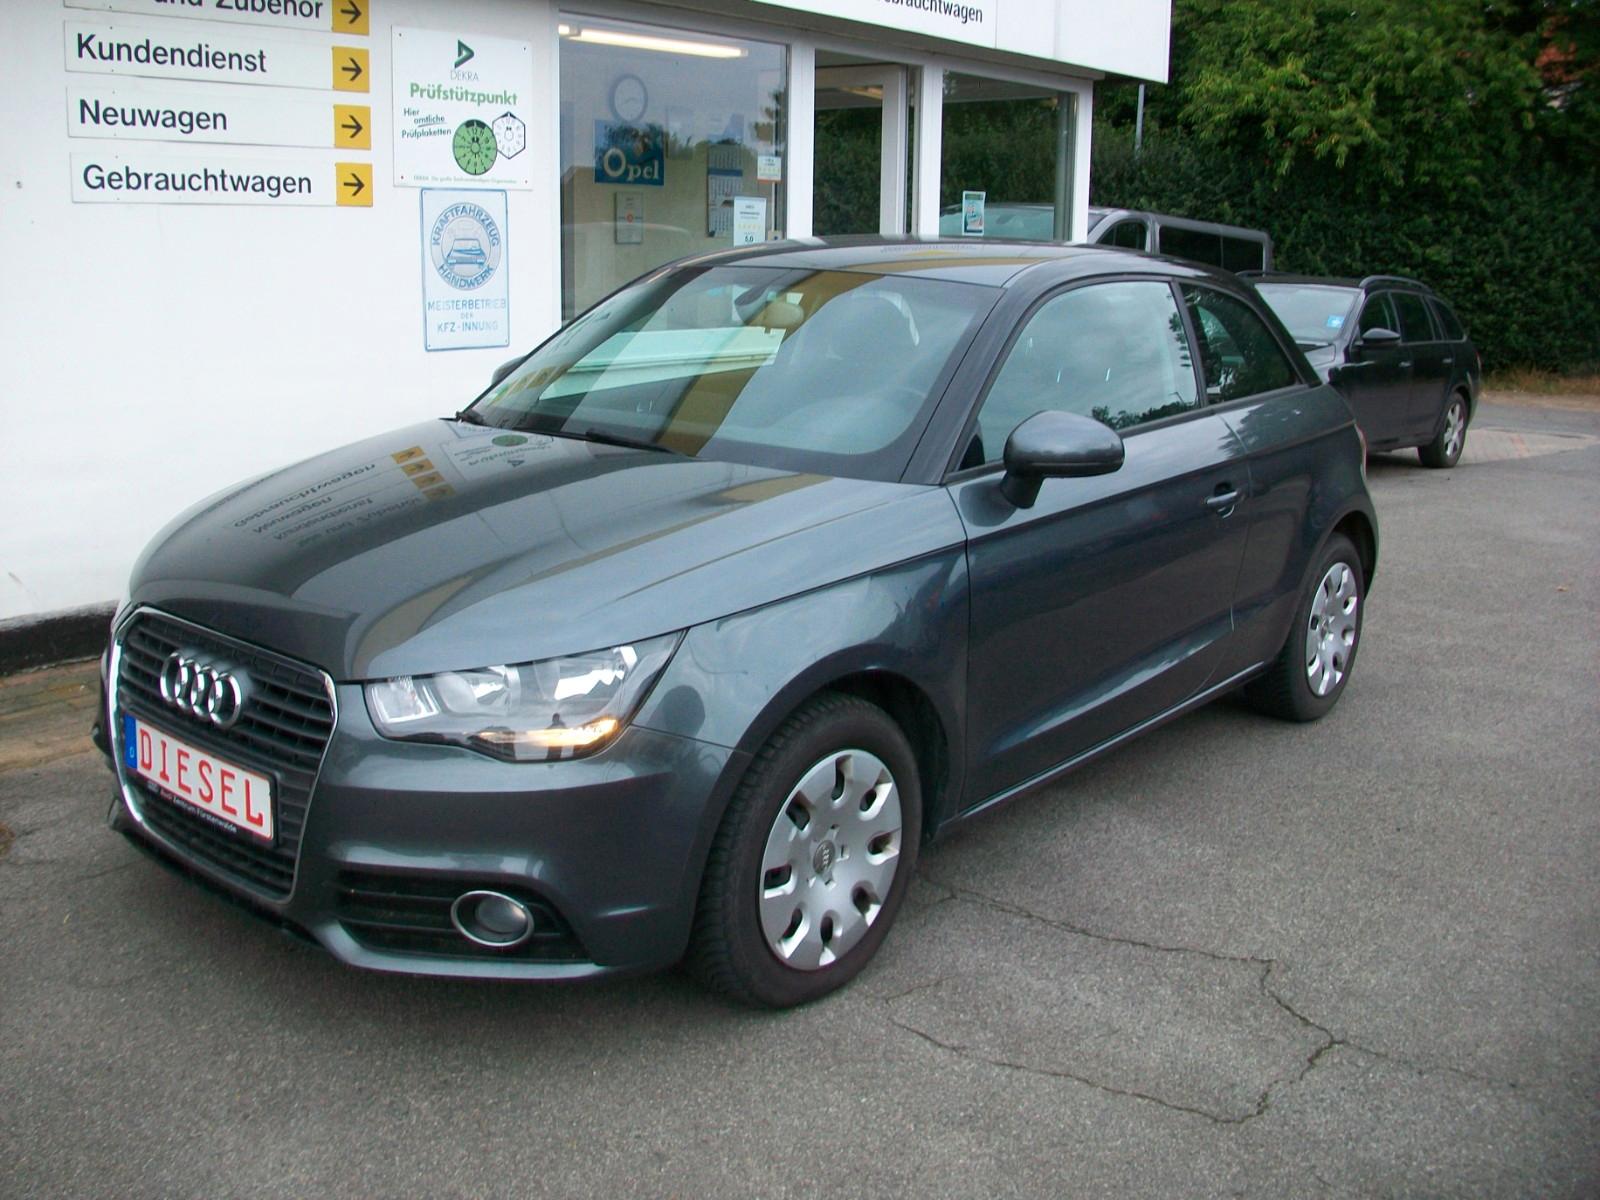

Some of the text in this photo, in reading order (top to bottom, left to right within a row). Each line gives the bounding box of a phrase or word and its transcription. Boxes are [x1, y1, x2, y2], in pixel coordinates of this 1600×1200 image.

[77, 32, 267, 73] Kundendienst
[450, 70, 479, 81] DEKRA
[410, 82, 518, 106] Prüfstützpunkt
[79, 98, 228, 134] Neuwagen
[403, 107, 420, 116] Hier
[413, 114, 446, 124] amtliche
[401, 128, 452, 139] Prüfplaketten
[603, 147, 660, 182] Opel
[83, 164, 312, 198] Gebrauchtwagen
[432, 205, 500, 246] KRAFTFAHRZEUG
[438, 263, 494, 289] HANDWERK
[427, 298, 507, 311] MEISTERBETRIEB
[130, 728, 264, 828] D DIESEL
